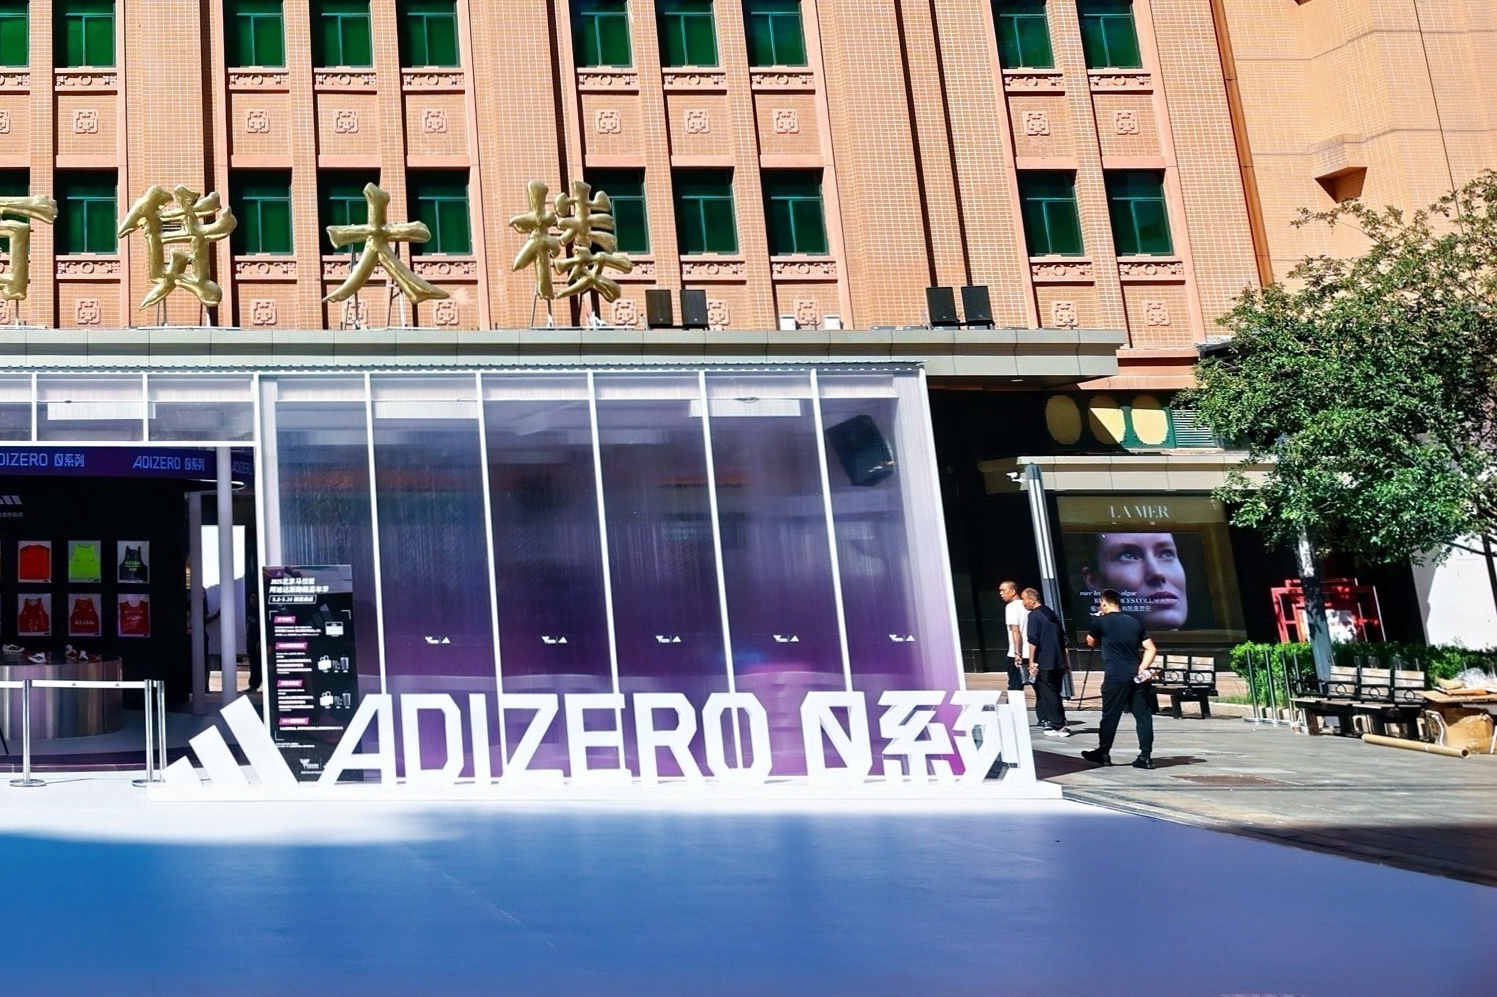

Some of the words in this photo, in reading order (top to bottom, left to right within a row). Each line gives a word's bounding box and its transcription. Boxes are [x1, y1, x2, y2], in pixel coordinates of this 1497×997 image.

[132, 455, 182, 470] ADIZERO
[1110, 505, 1131, 518] LA
[1135, 505, 1170, 518] MER
[318, 692, 773, 786] ADIZERO
